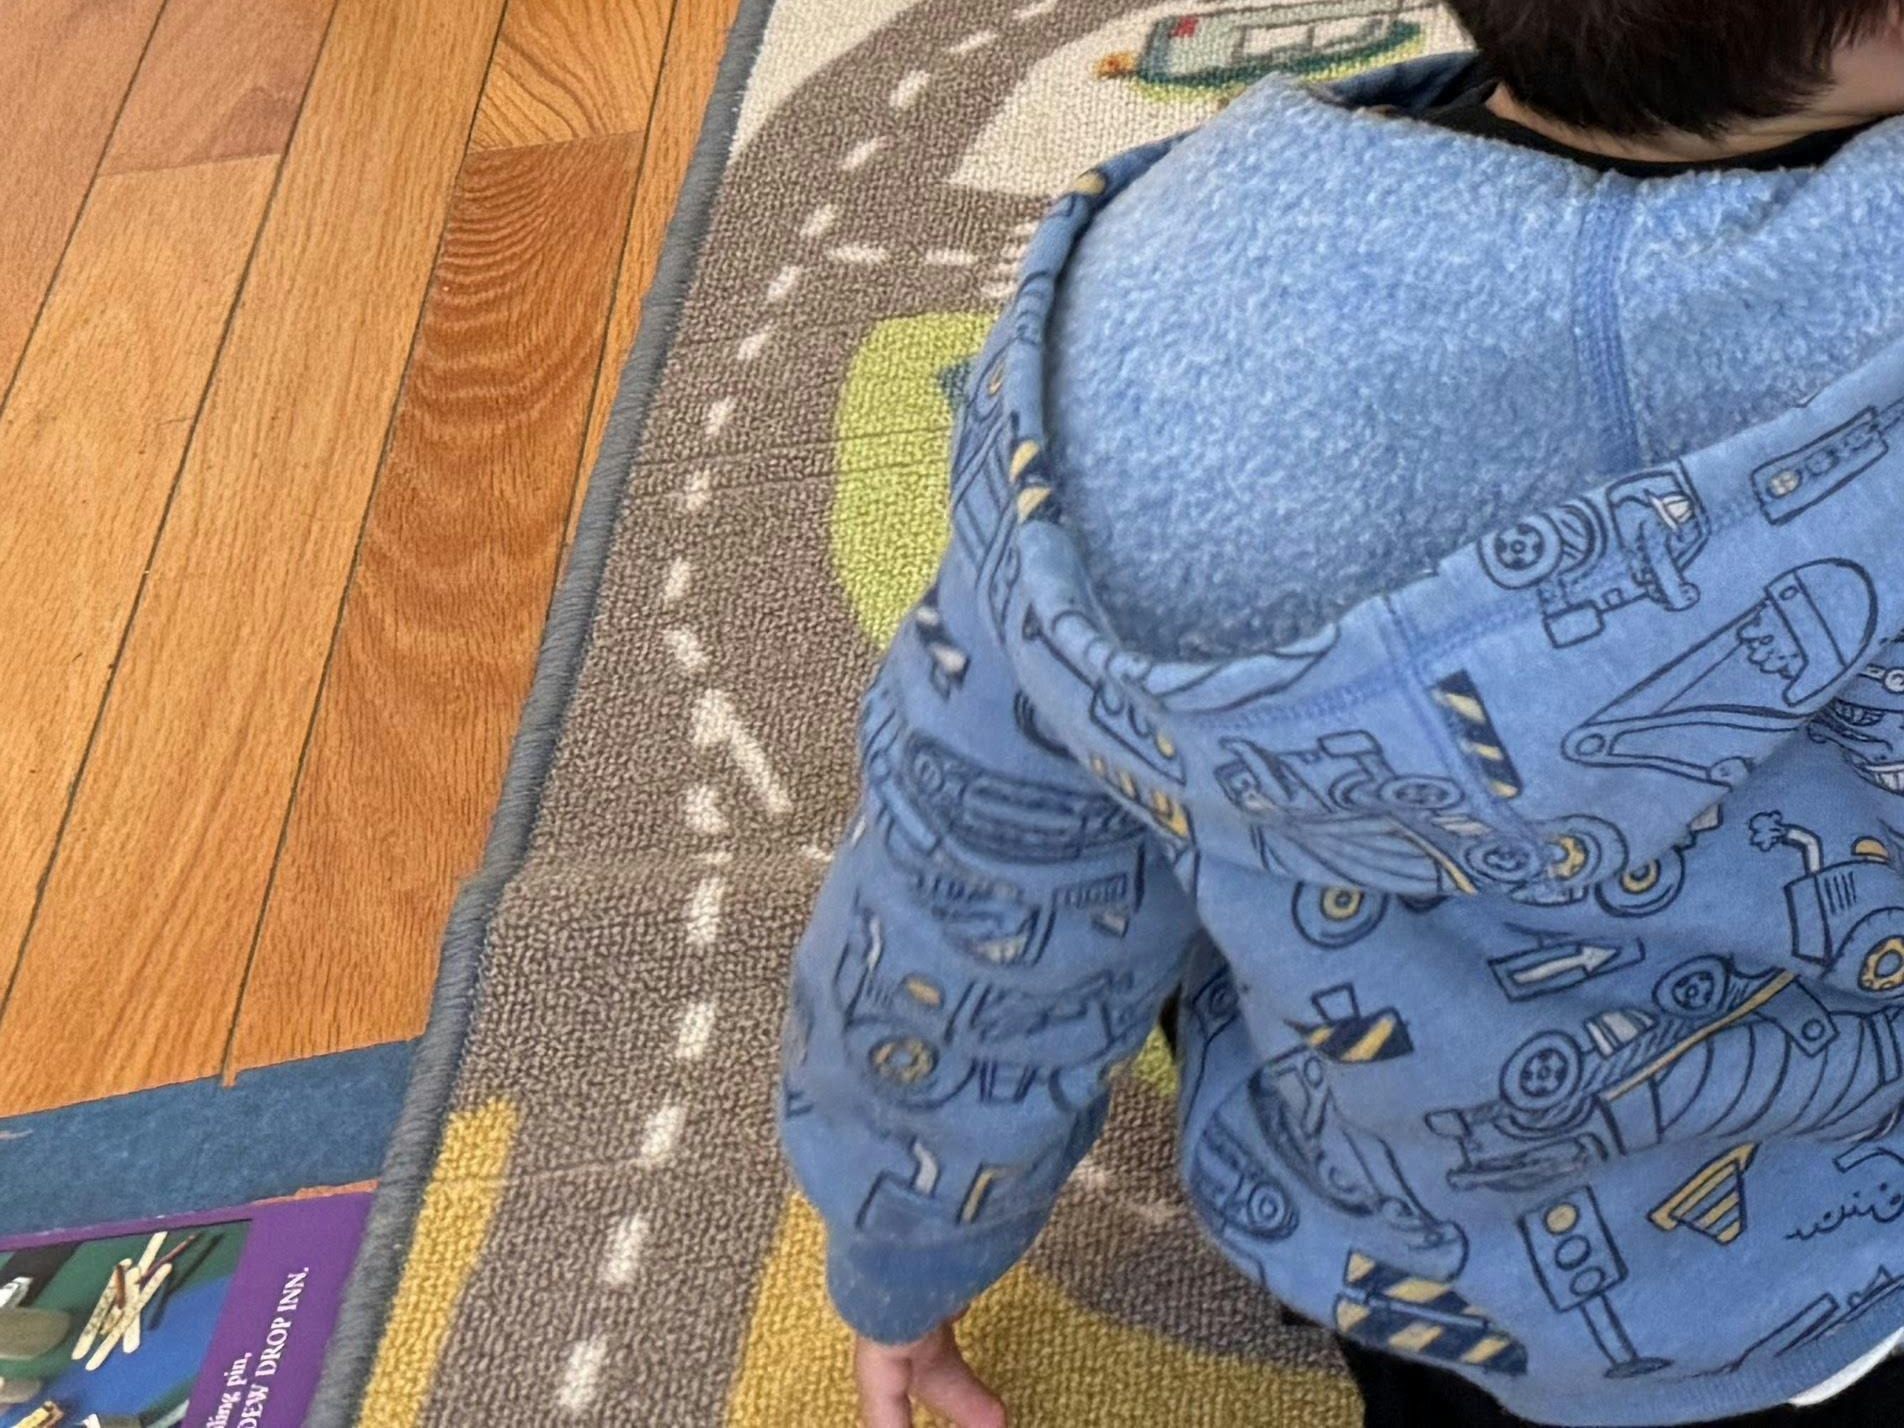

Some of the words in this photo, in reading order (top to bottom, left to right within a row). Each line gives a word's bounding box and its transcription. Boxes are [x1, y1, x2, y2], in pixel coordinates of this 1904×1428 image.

[255, 1317, 292, 1376] DROP
[277, 1266, 309, 1312] INN.
[224, 1352, 252, 1387] pin,
